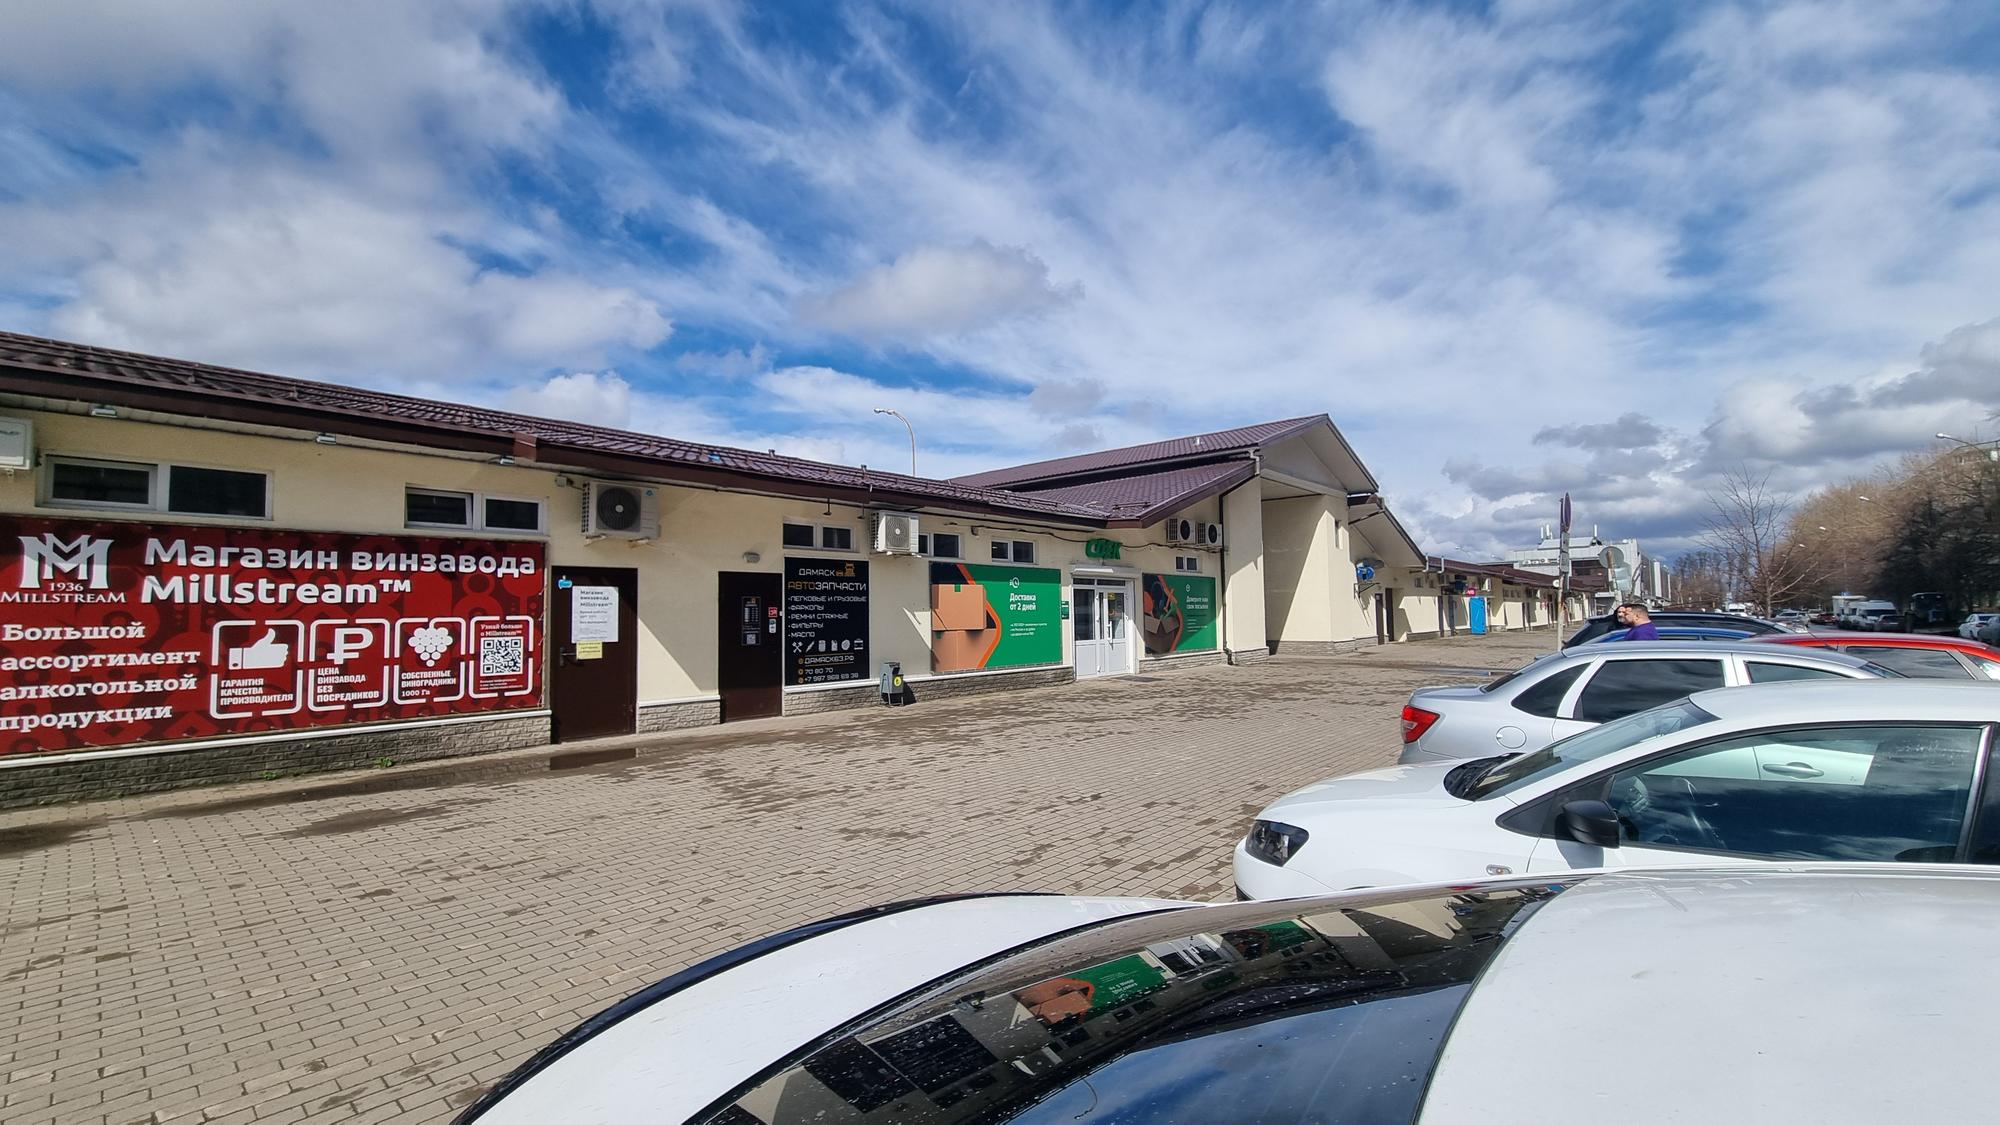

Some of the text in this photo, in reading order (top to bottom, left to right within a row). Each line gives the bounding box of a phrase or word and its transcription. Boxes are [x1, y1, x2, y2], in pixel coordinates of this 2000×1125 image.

[144, 537, 535, 578] Магазин винзавода
[798, 568, 836, 577] ДАМАСК
[49, 582, 84, 592] 1936
[787, 581, 867, 591] АВТОЗАПЧАСТИ
[1010, 592, 1036, 602] Доставка
[1022, 602, 1036, 612] дней
[2, 621, 146, 641] Большой
[1, 651, 200, 672] ассортимент
[317, 667, 340, 676] ЦЕНА
[401, 670, 452, 680] СОБСТВЕННЫЕ
[220, 678, 265, 688] ГАРАНТИЯ
[317, 675, 367, 685] ВИНЗАВОДА
[401, 677, 457, 688] ВИНОГРАДНИКИ
[0, 674, 198, 700] алкогольной
[220, 687, 264, 697] КАЧЕСТВА
[316, 685, 334, 694] БЕЗ
[316, 691, 380, 703] ПОСРЕДНИКОВ
[401, 689, 420, 697] 1000
[220, 693, 294, 706] ПРОИЗВОДИТЕЛЯ
[0, 705, 173, 733] продукции
